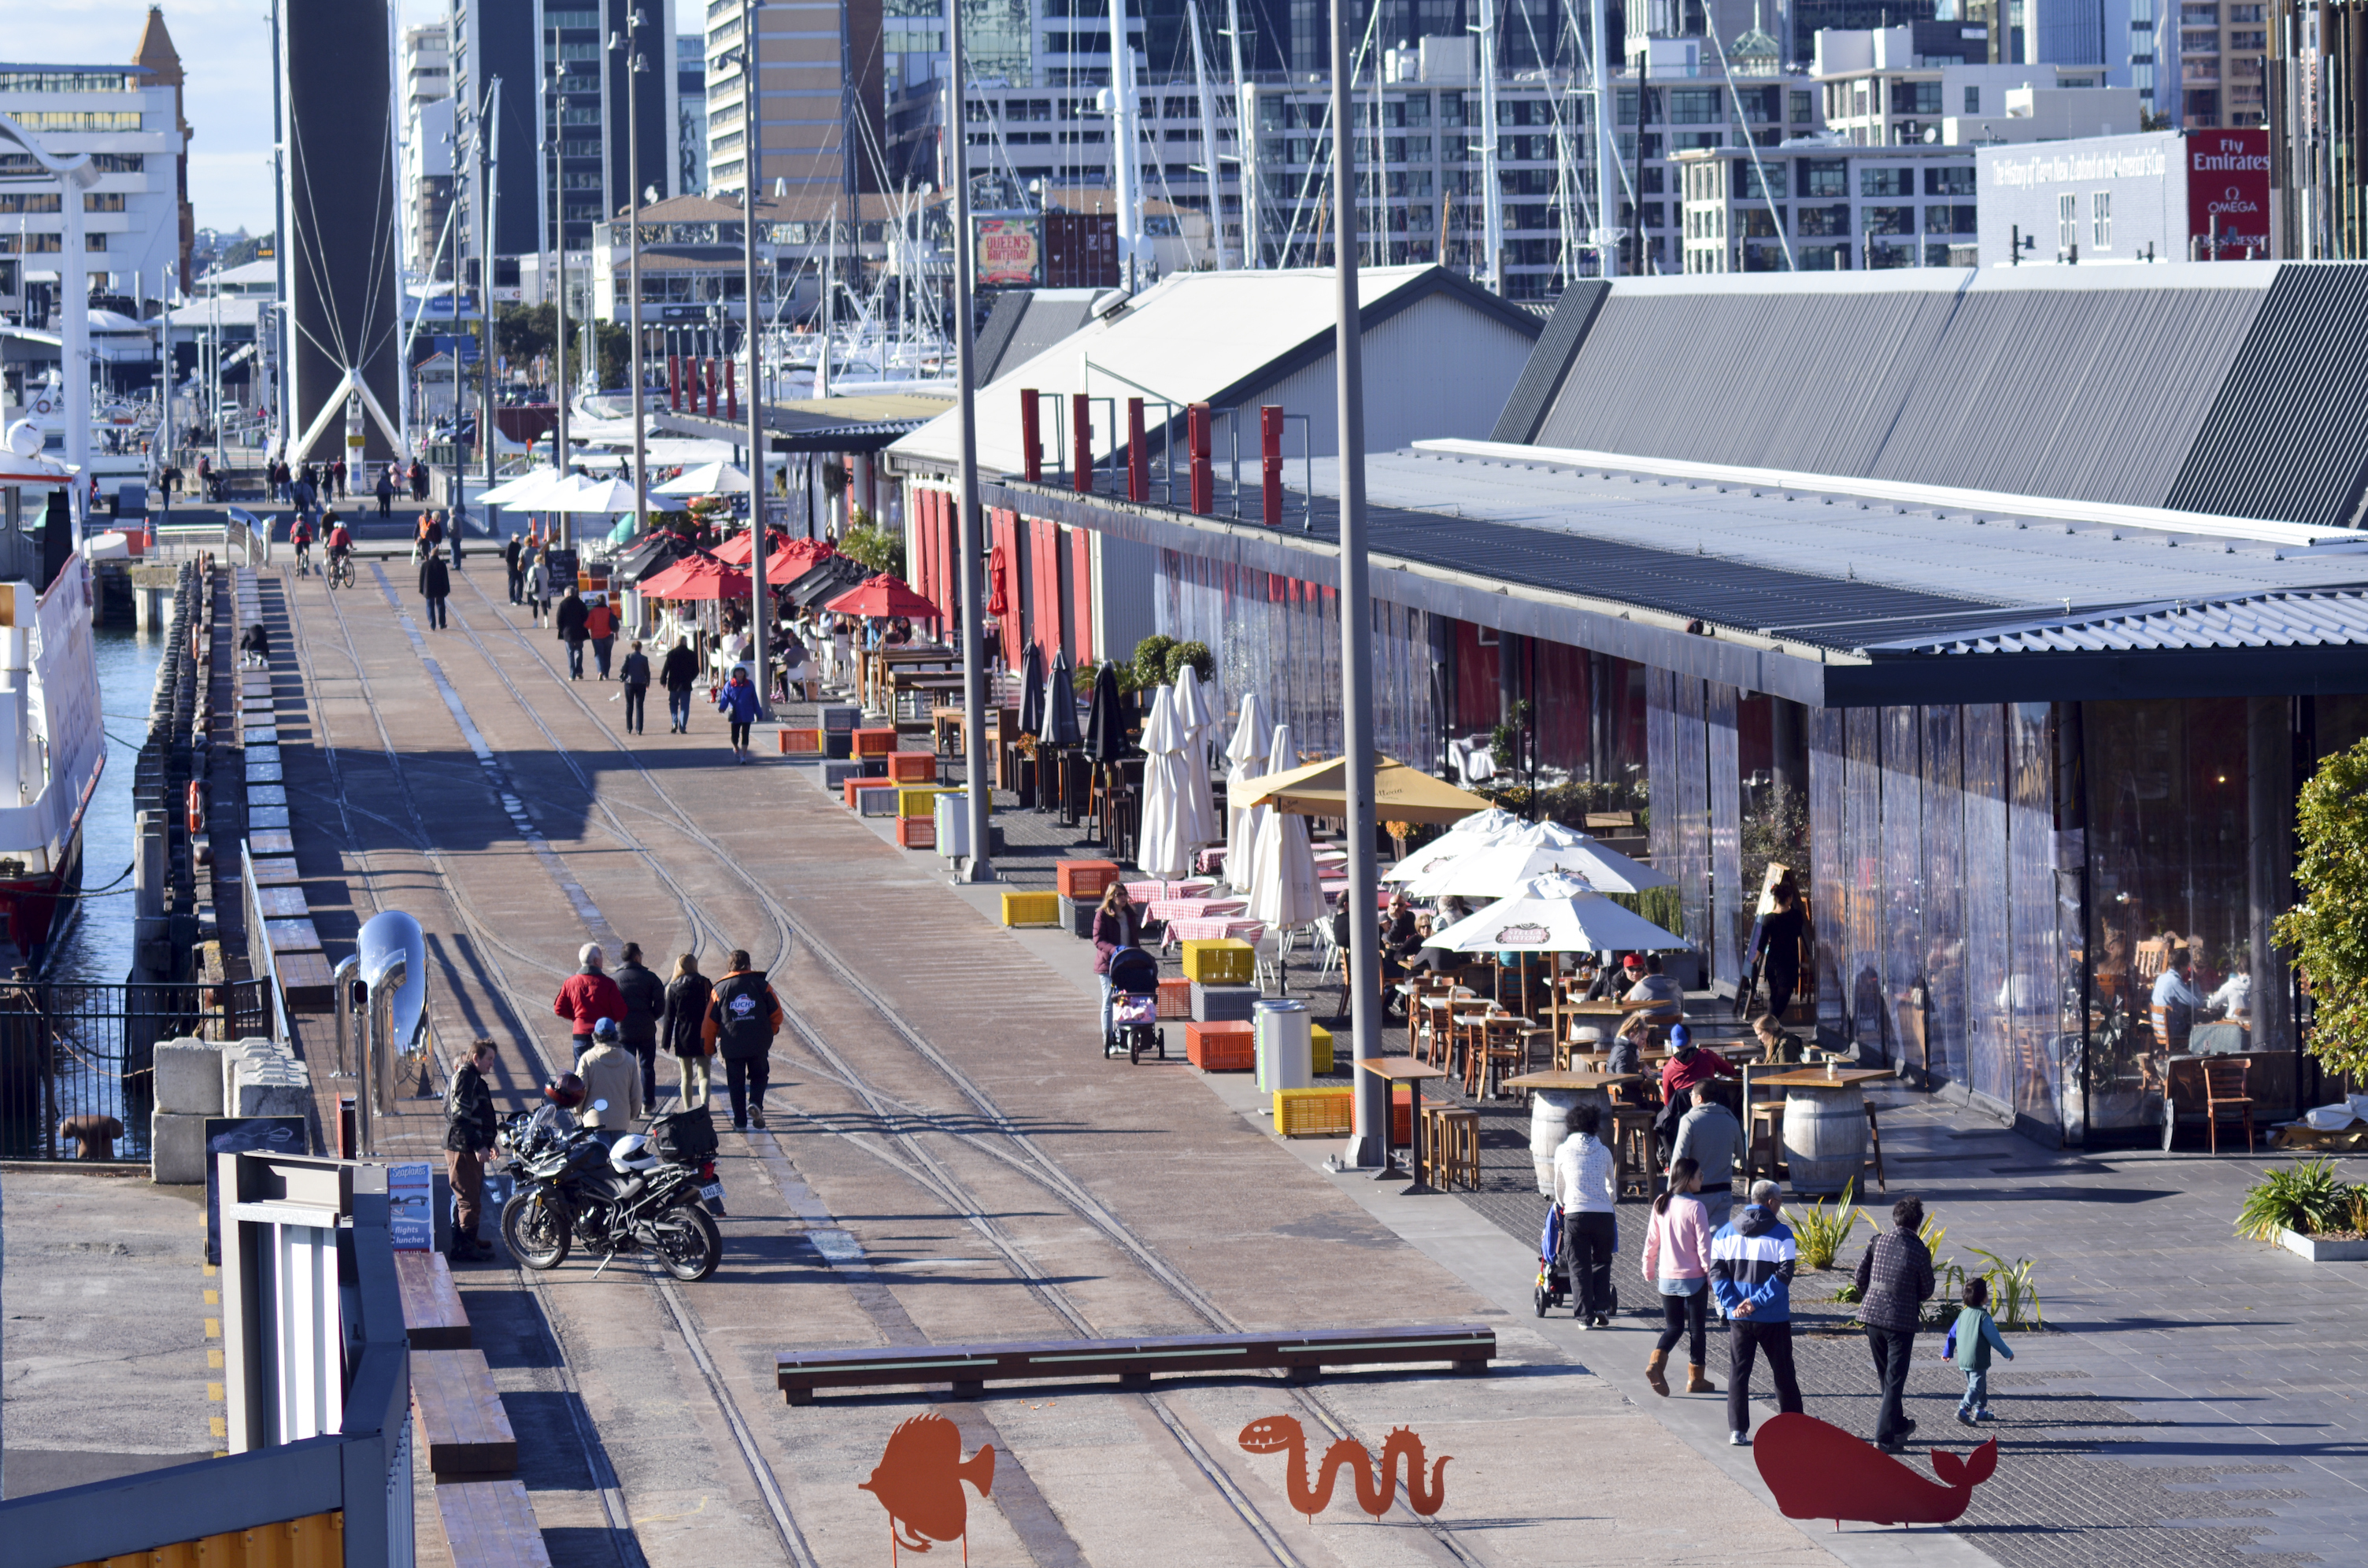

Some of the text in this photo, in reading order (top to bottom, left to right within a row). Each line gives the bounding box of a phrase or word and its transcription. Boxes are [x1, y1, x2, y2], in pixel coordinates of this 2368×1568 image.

[2220, 139, 2244, 153] Fly
[1992, 147, 2166, 190] The History of Team New Zealand in the America's Cup
[2193, 153, 2270, 171] Emirates
[2207, 202, 2258, 213] OMEGA
[986, 235, 1030, 250] QUEEN'S
[987, 249, 1030, 261] BIRTHDAY
[393, 1166, 426, 1178] Seaplanes
[395, 1226, 419, 1235] flights
